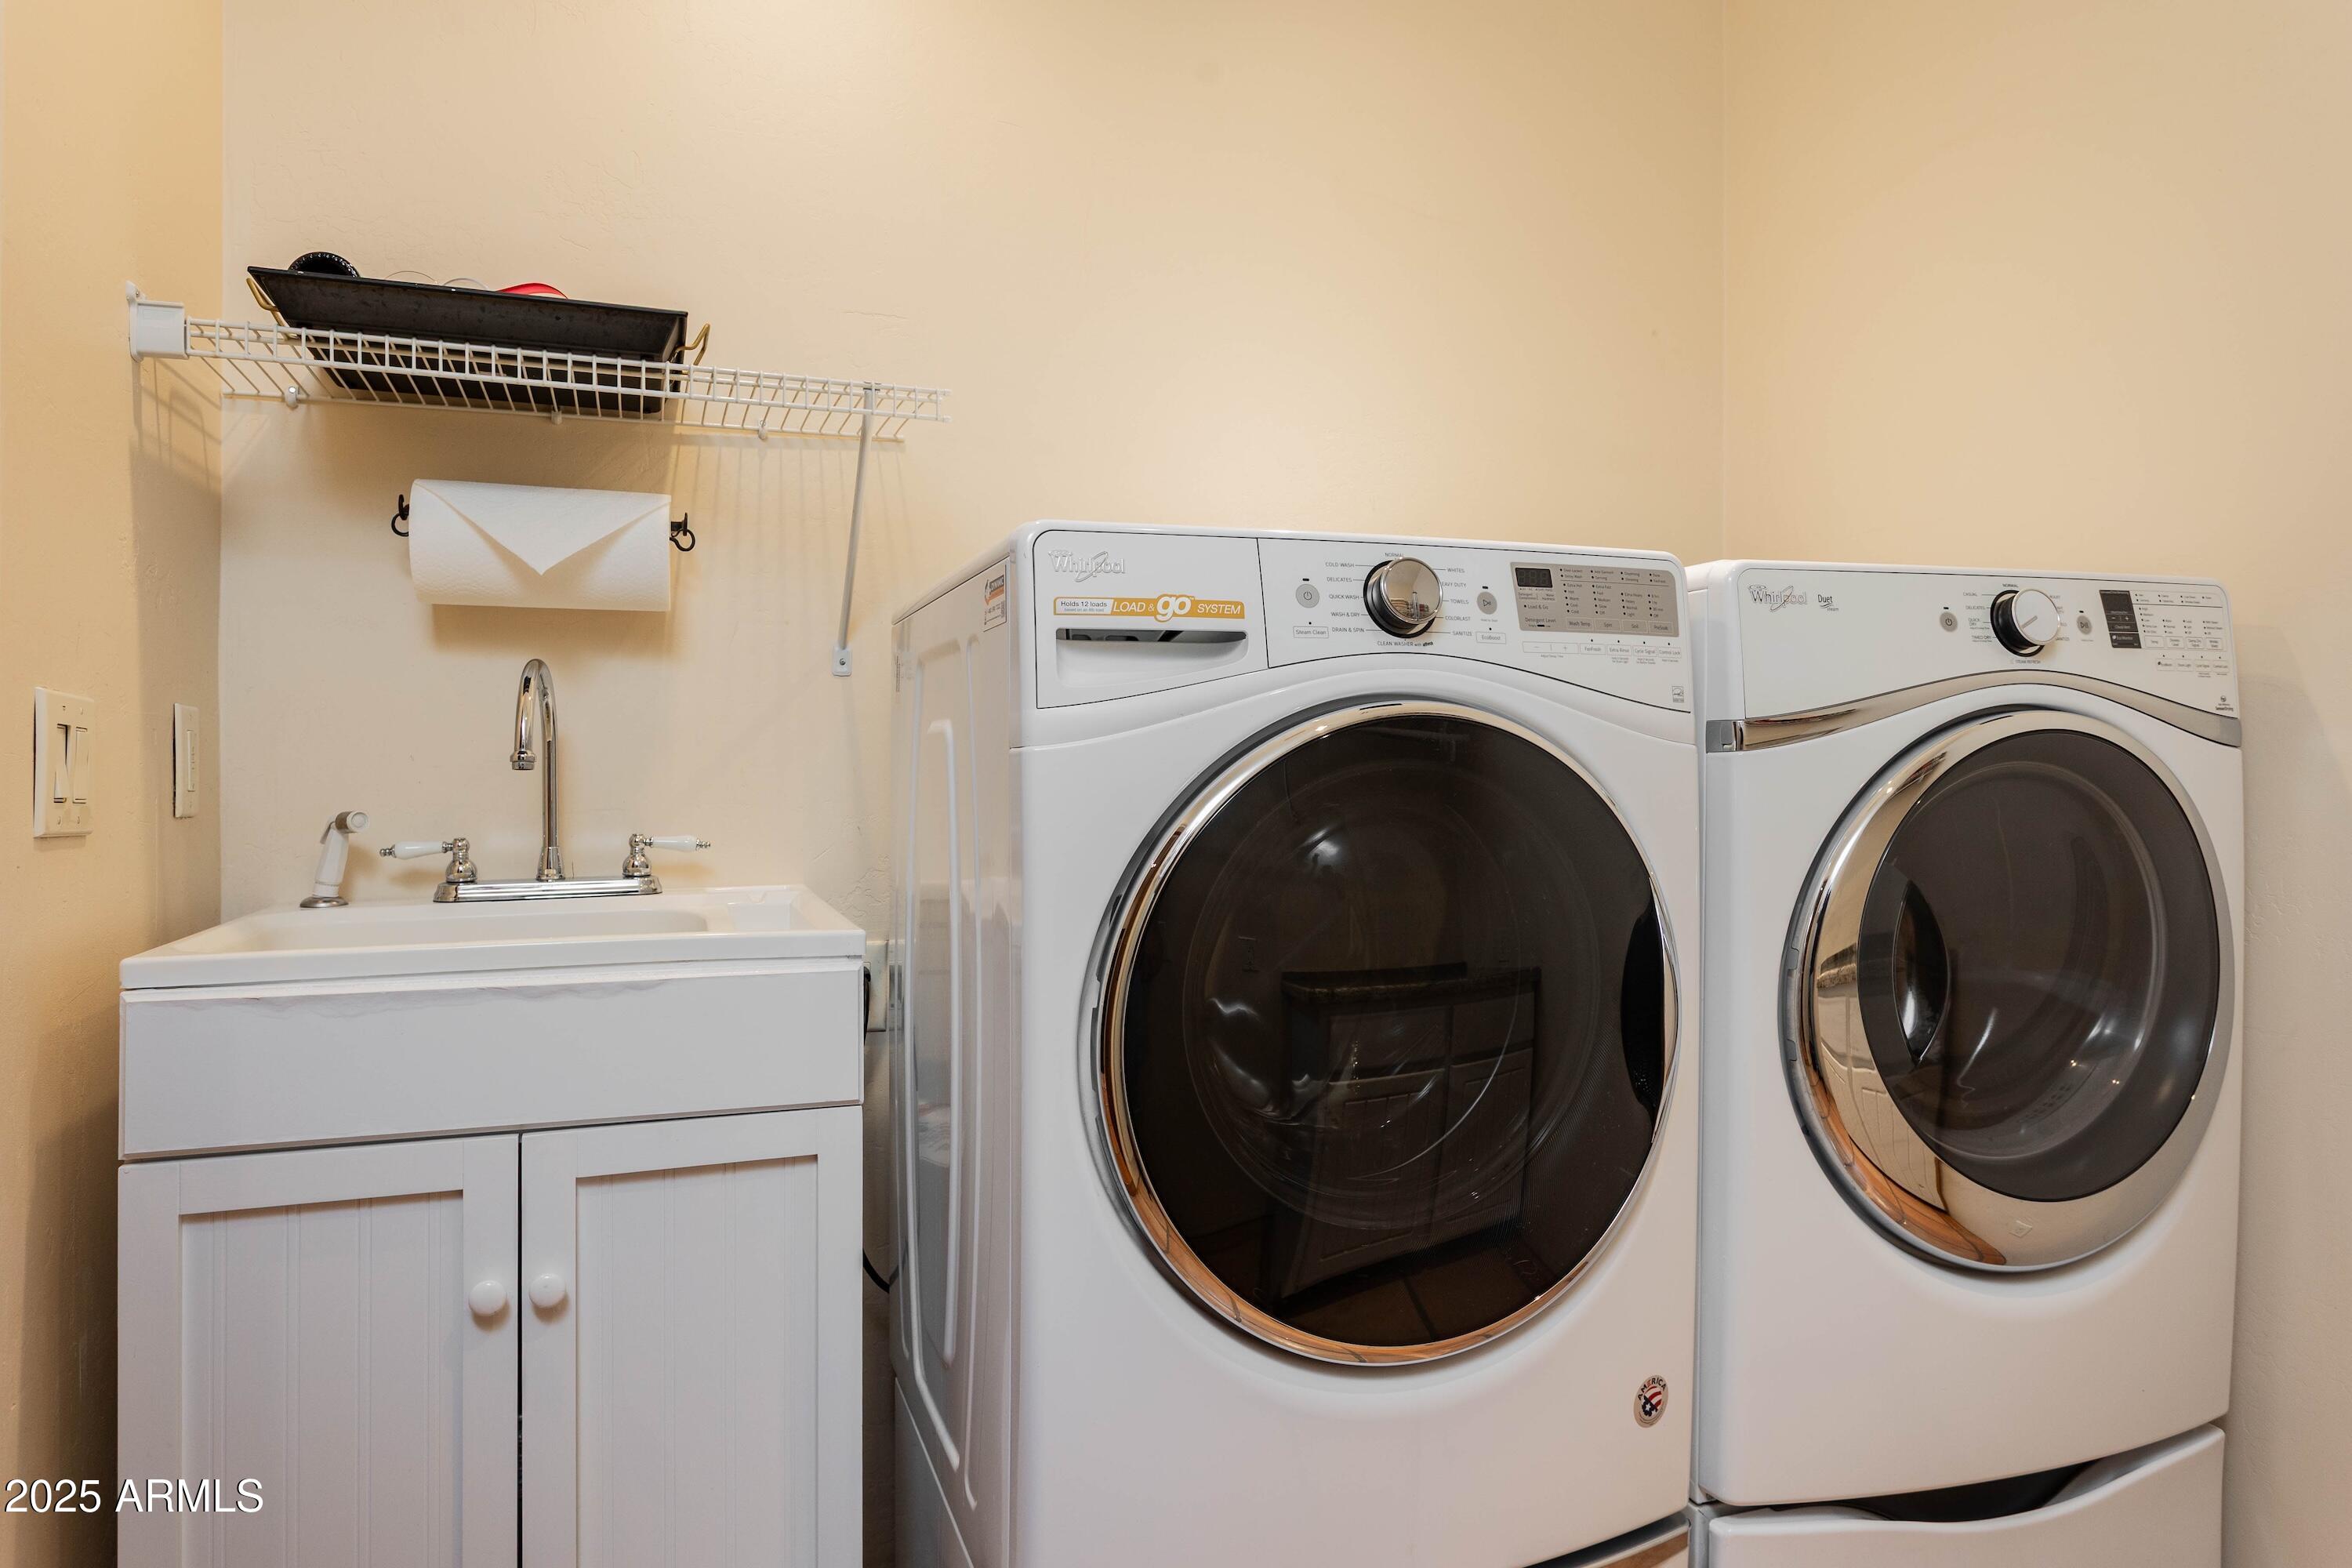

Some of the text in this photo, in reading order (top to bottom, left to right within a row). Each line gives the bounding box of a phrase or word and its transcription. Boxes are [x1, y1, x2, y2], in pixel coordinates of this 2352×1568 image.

[1051, 554, 1126, 578] Whirlpool
[1113, 596, 1241, 621] LOAD & go SYSTEM
[1751, 590, 1807, 608] Whirlpool
[1817, 593, 1833, 603] Duet
[1638, 1377, 1667, 1401] AMERICA
